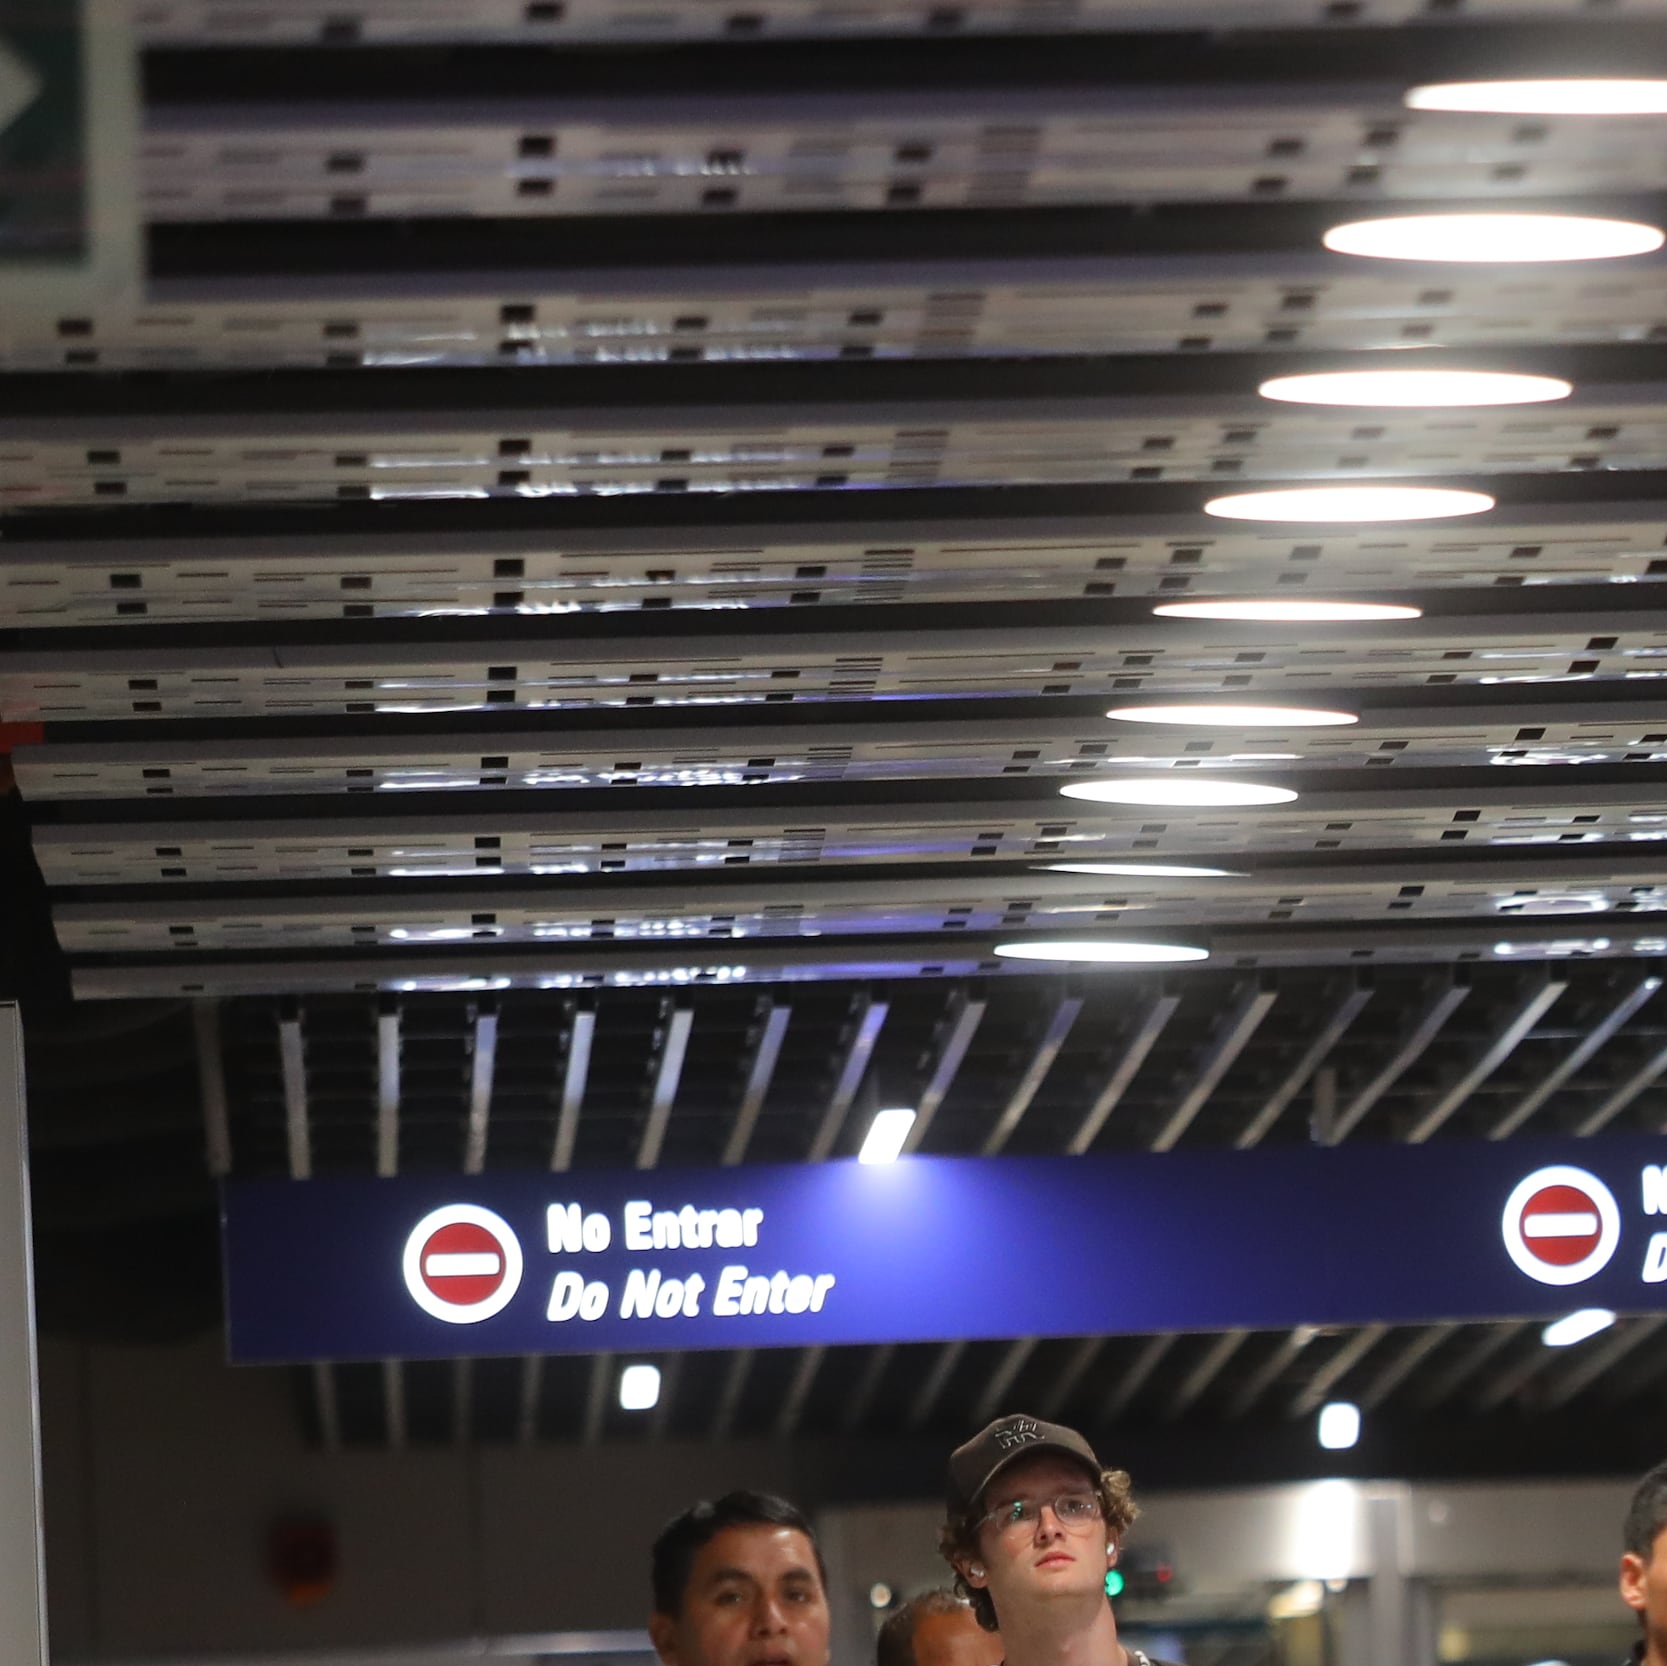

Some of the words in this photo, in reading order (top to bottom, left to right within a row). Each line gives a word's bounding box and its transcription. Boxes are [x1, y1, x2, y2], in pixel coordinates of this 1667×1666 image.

[546, 1202, 611, 1254] No
[624, 1201, 765, 1251] Entrar
[546, 1270, 611, 1323] Do
[619, 1267, 706, 1320] Not
[712, 1264, 837, 1317] Enter
